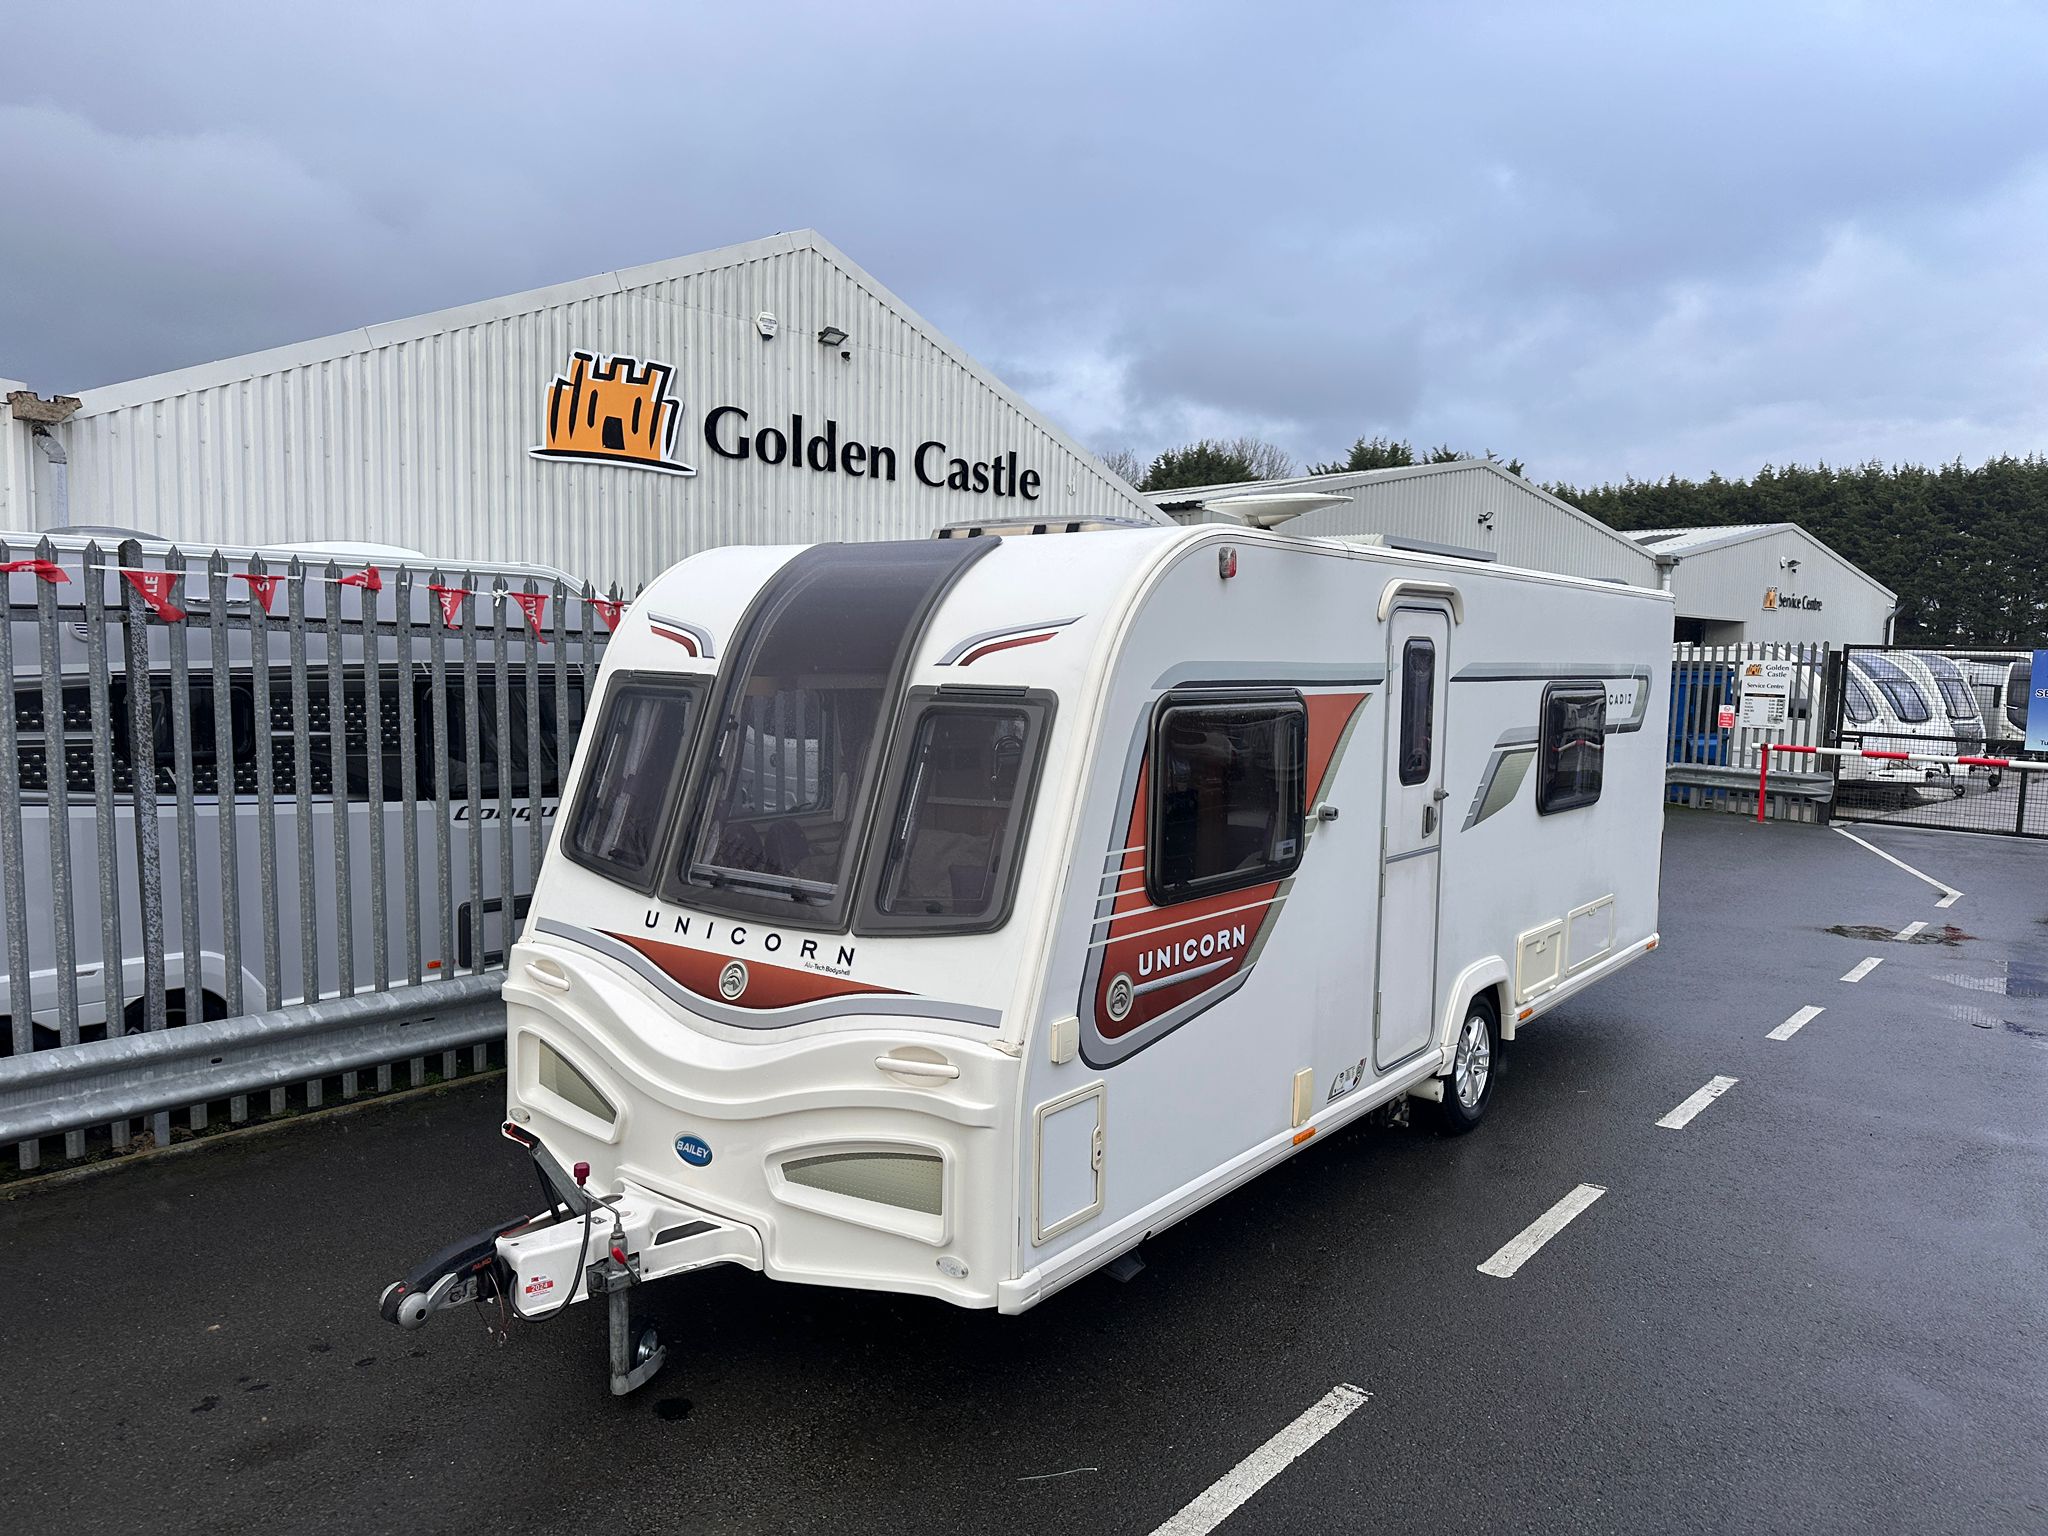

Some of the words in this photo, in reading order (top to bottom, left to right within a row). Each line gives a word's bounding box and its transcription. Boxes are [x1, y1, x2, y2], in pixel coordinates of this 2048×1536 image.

[704, 405, 896, 481] Golden
[915, 440, 1041, 501] Castle
[1779, 592, 1801, 609] Service
[1802, 595, 1822, 611] Centre
[1608, 693, 1632, 705] CADIZ
[644, 910, 855, 967] UNICORN
[1138, 924, 1246, 977] UNICORN
[825, 965, 851, 976] Bodyshell
[676, 1140, 710, 1159] BAILEY
[531, 1283, 548, 1292] 2024
